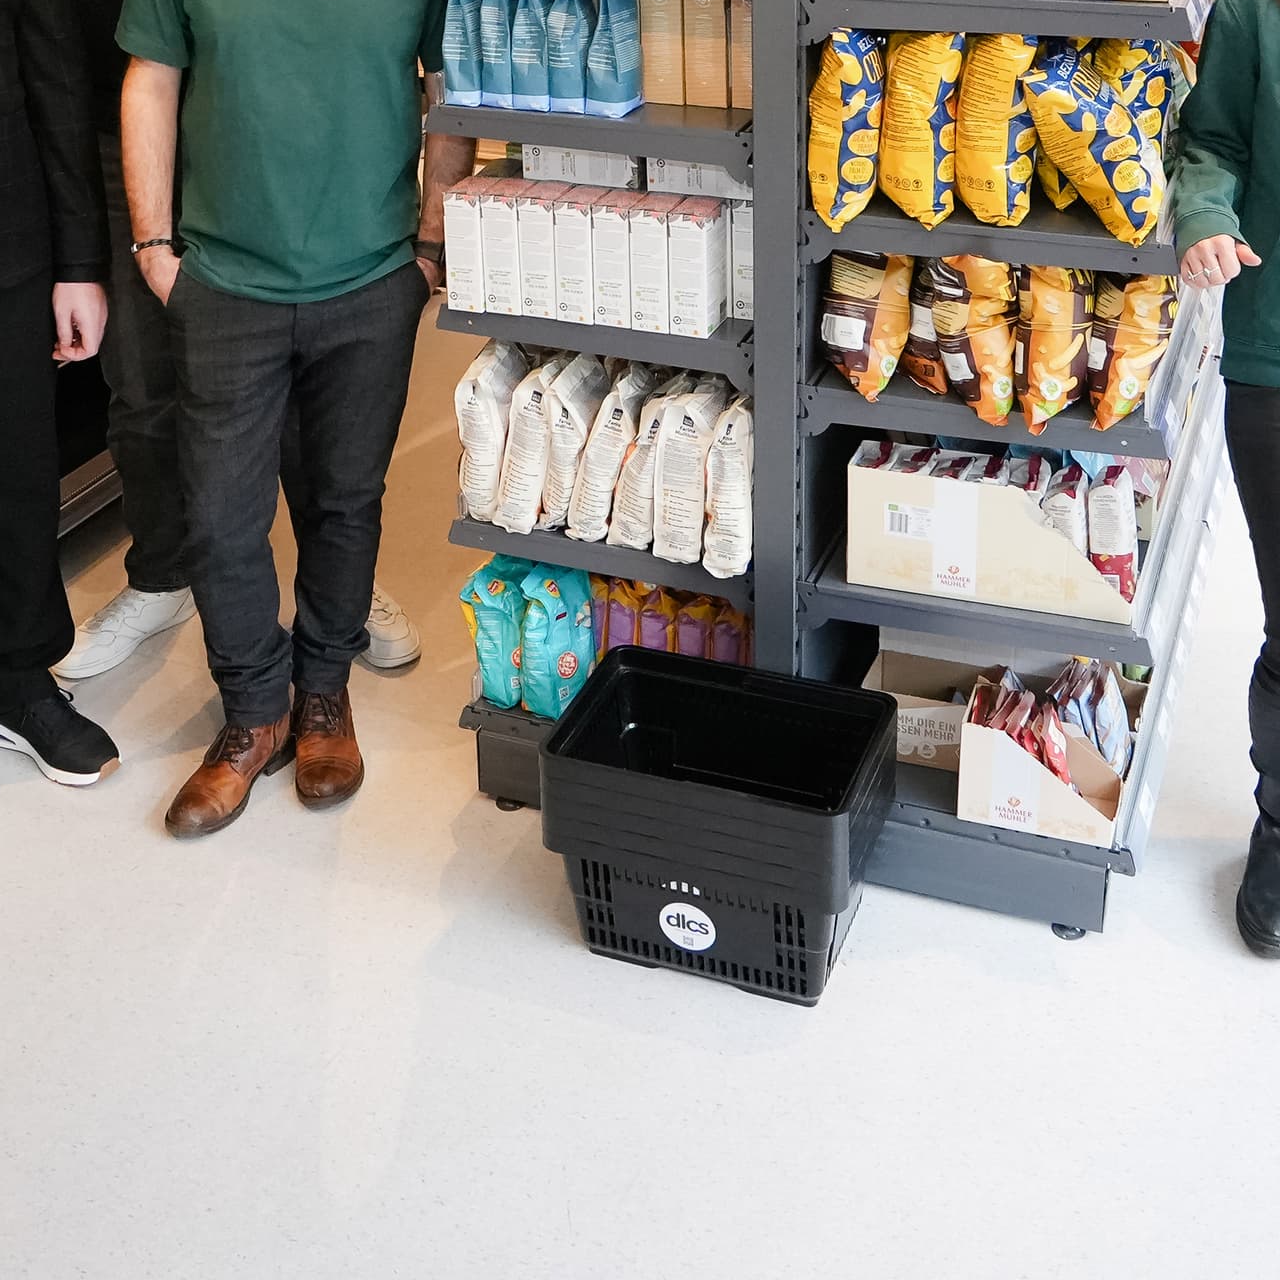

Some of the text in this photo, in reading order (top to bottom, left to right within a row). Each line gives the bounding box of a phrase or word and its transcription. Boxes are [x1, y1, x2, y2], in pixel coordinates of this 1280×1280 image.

[936, 573, 971, 584] HAMMER
[940, 579, 967, 588] MÜHLE
[913, 718, 936, 729] DIR
[939, 721, 956, 732] EIN
[924, 729, 954, 740] MEHR
[995, 805, 1032, 817] HAMMER
[998, 812, 1027, 823] MÜHLE
[666, 913, 709, 935] dlcs
